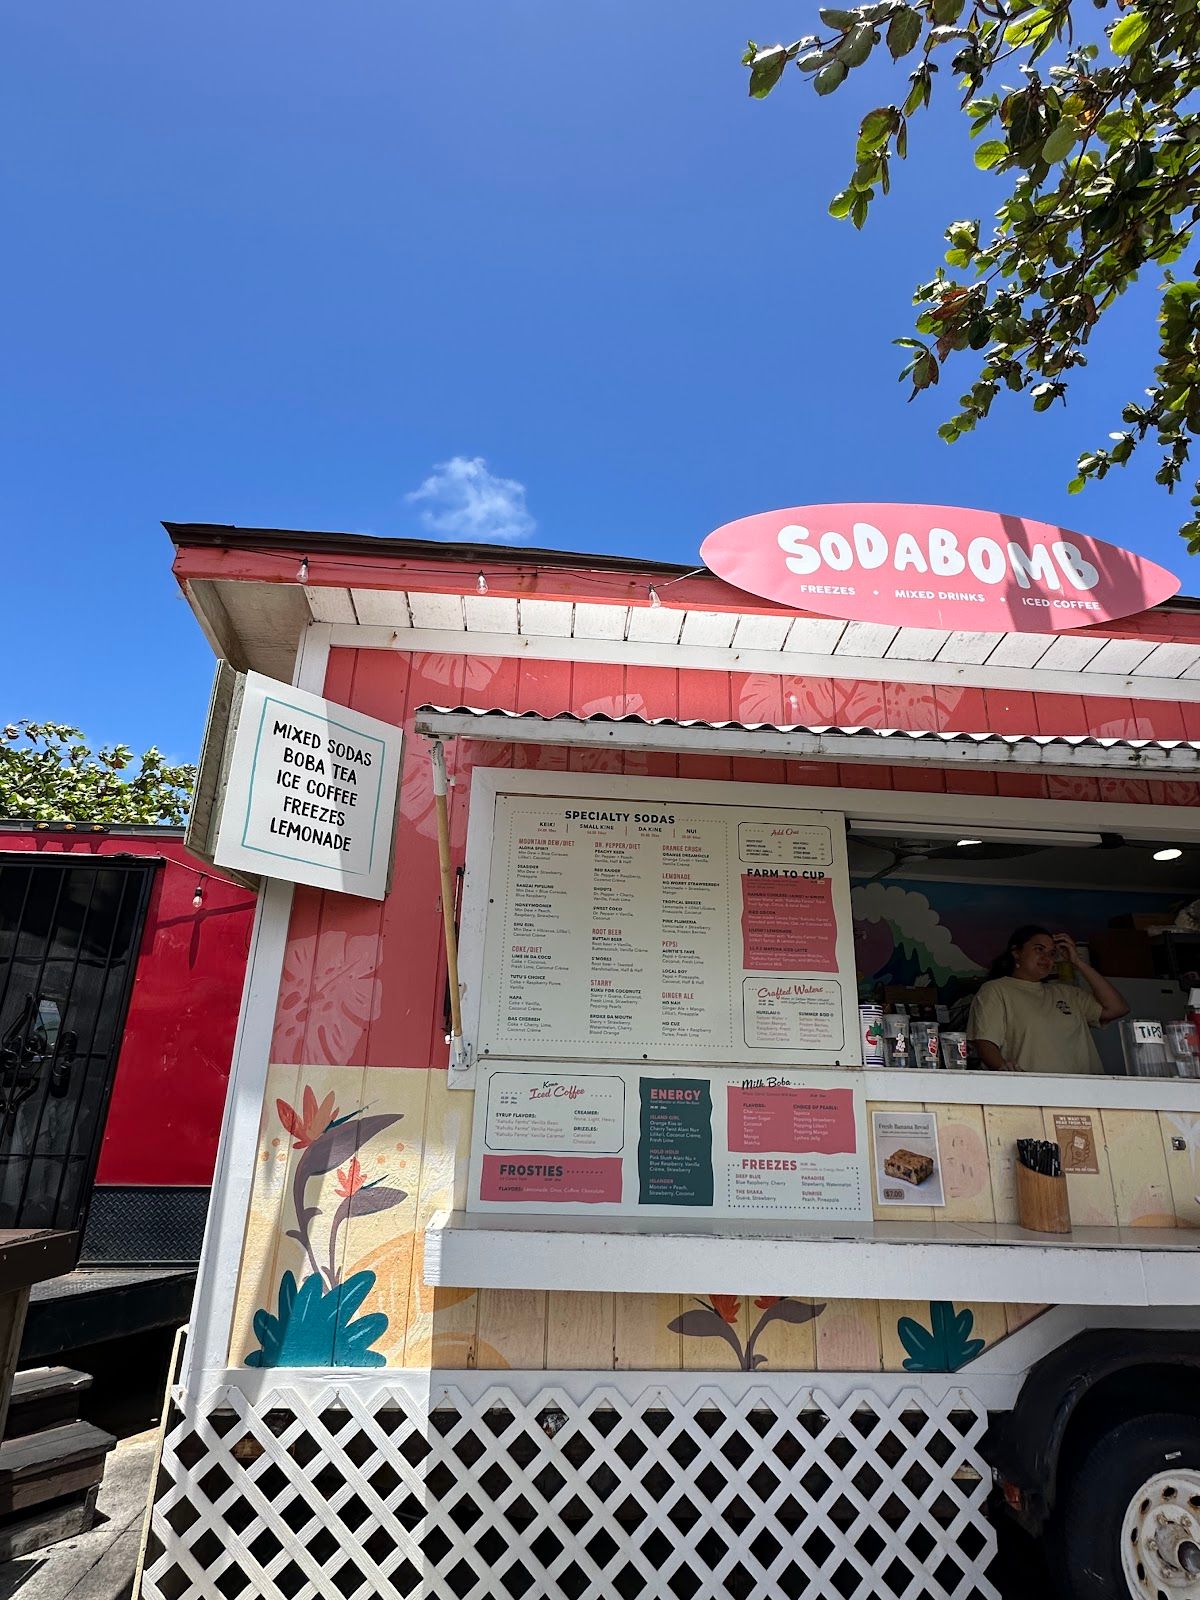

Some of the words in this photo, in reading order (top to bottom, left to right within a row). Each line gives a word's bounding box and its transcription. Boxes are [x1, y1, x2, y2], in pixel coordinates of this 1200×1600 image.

[801, 584, 855, 596] FREEZES
[895, 590, 934, 600] MIXED
[938, 591, 985, 602] DRINKS
[1023, 598, 1050, 608] ICED
[1053, 599, 1100, 610] COFFEE
[273, 720, 321, 748] MIXED
[327, 740, 372, 766] SODAS
[283, 748, 324, 775] BOBA
[333, 764, 357, 785] TEA
[277, 770, 301, 789] ICE
[307, 779, 358, 806] COFFEE
[284, 796, 344, 826] FREEZES
[565, 810, 630, 822] SPECIALTY
[634, 814, 676, 824] SODAS
[270, 817, 351, 851] LEMONADE
[747, 868, 778, 878] FARM
[783, 870, 798, 879] TO
[802, 870, 825, 880] CUP
[758, 987, 792, 999] Crafted
[794, 984, 823, 995] Waters
[1138, 1026, 1162, 1039] TIPS
[742, 1080, 765, 1090] Milk
[767, 1077, 791, 1088] Boba
[529, 1088, 551, 1100] Iced
[553, 1085, 585, 1099] Coffee
[650, 1088, 701, 1100] ENERGY
[500, 1165, 563, 1176] FROSTIES
[742, 1159, 798, 1171] FREEZES
